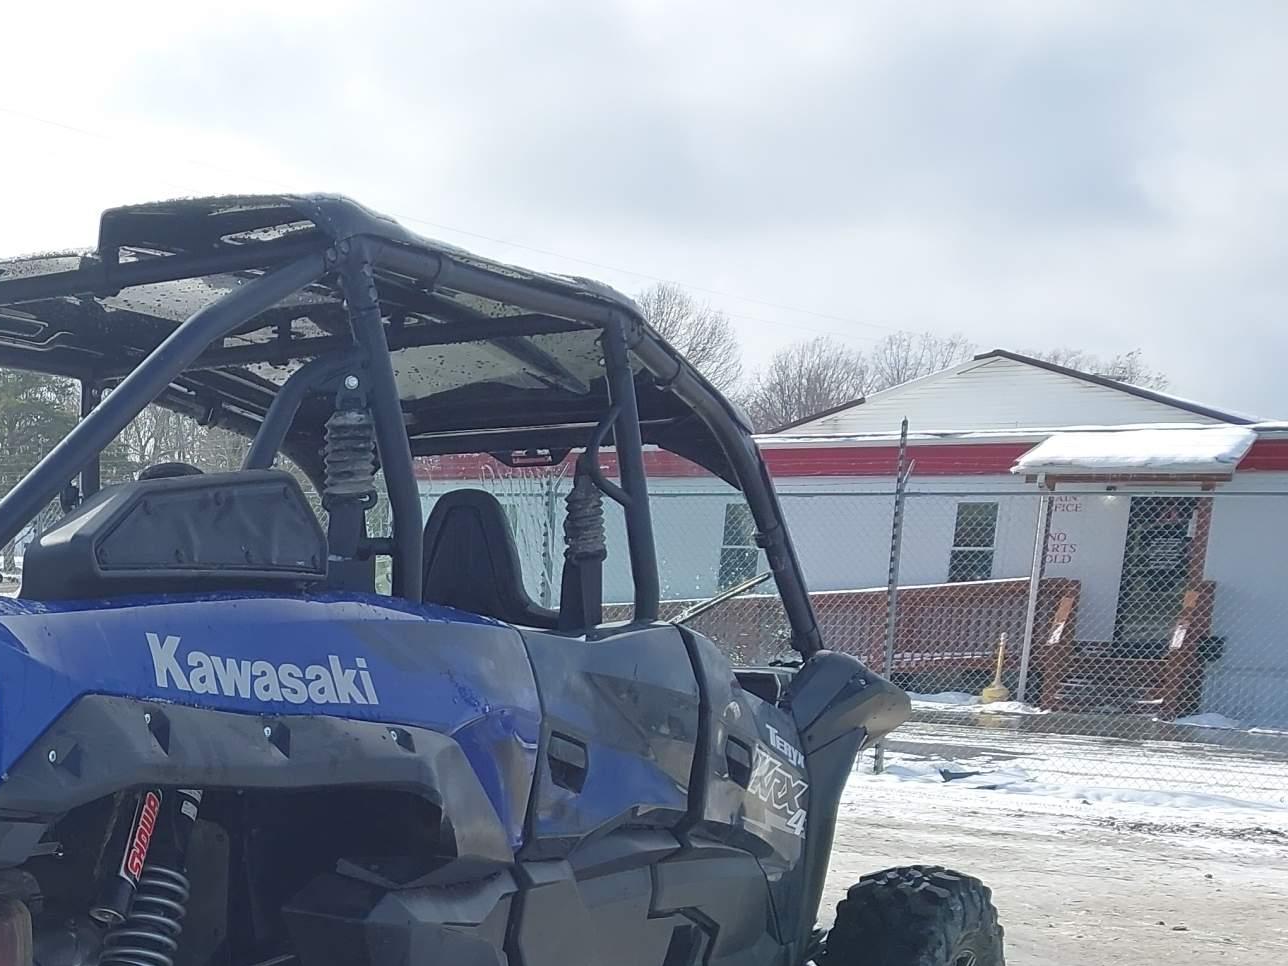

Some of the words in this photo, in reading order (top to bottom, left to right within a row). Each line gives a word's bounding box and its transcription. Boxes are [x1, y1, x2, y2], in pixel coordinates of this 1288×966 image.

[1045, 554, 1072, 564] OLD
[145, 632, 379, 705] Kawasaki
[128, 791, 160, 882] SHOWA
